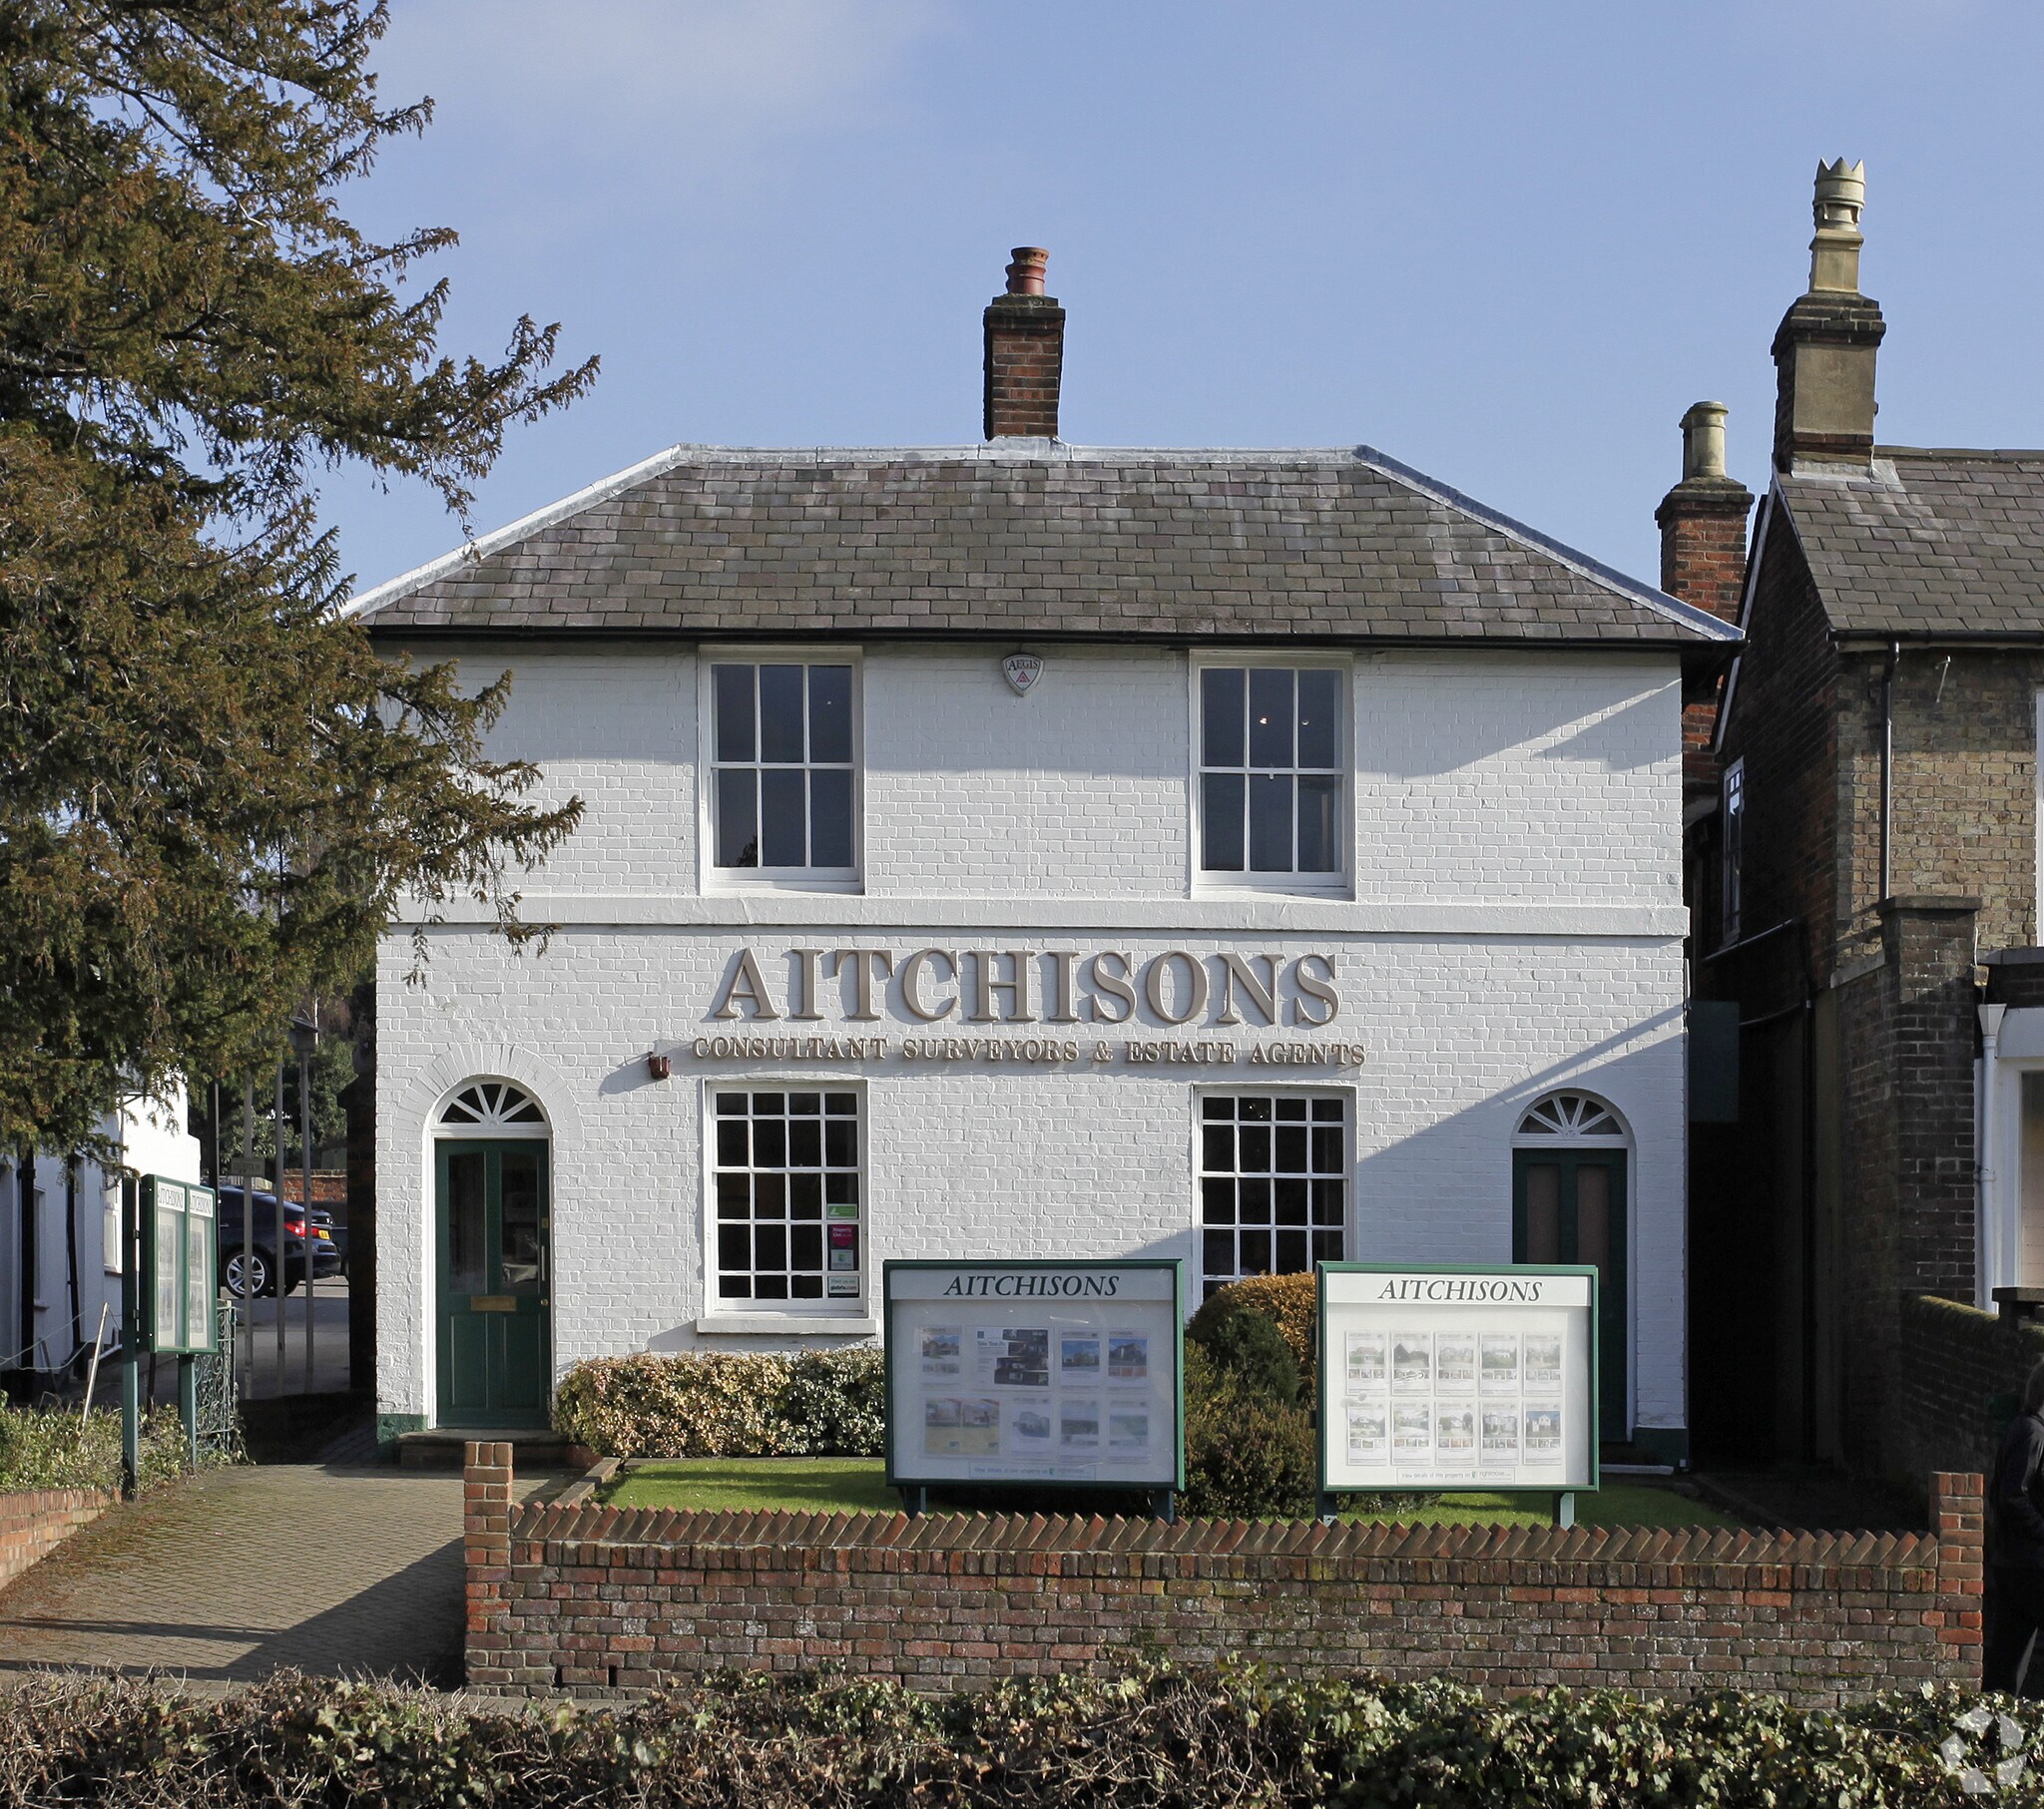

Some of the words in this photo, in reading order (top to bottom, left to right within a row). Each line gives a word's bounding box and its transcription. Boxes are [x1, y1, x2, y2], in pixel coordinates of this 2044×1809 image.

[1008, 660, 1038, 671] AEGIS
[714, 947, 1340, 1026] AITCHISONS
[692, 1036, 889, 1059] CONSULTANT
[902, 1038, 1080, 1061] SURVEYORS
[1094, 1041, 1114, 1063] &
[1125, 1041, 1238, 1064] ESTATE
[1251, 1042, 1367, 1065] AGENTS
[943, 1275, 1120, 1296] AITCHISONS
[1377, 1279, 1543, 1302] AITCHISONS
